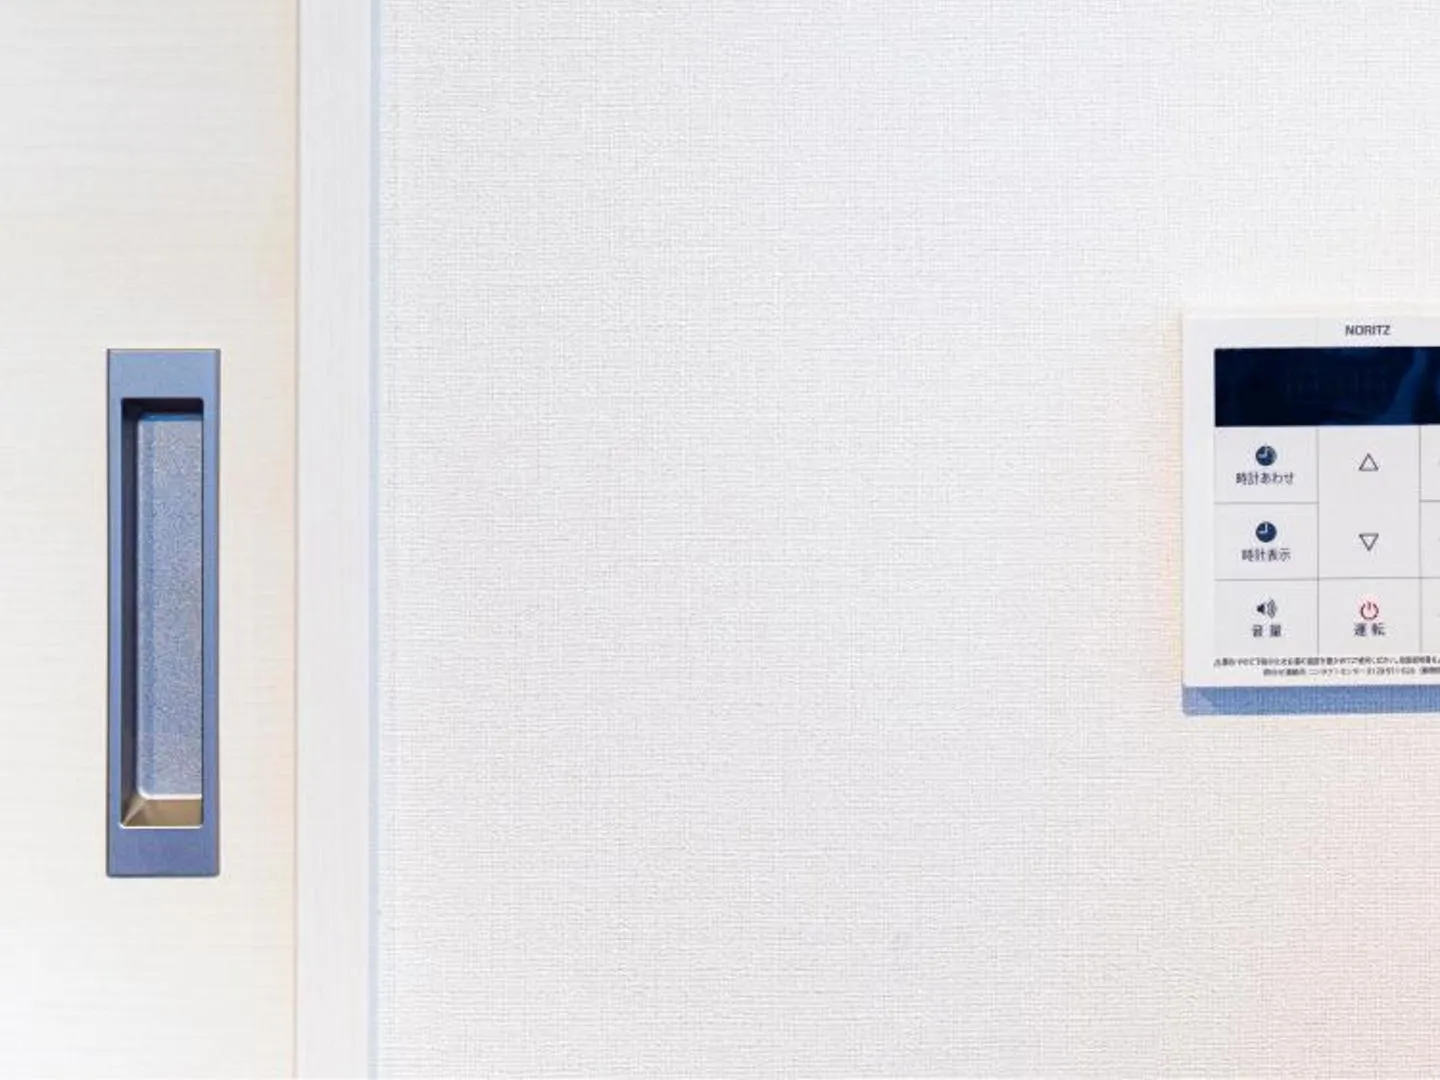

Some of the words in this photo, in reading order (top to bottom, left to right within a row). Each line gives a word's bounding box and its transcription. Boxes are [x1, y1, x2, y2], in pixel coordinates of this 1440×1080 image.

[1345, 324, 1391, 336] NORITZ
[1235, 471, 1294, 486] 時計あわせ
[1241, 547, 1292, 562] 時計表示
[1354, 623, 1386, 637] 運転
